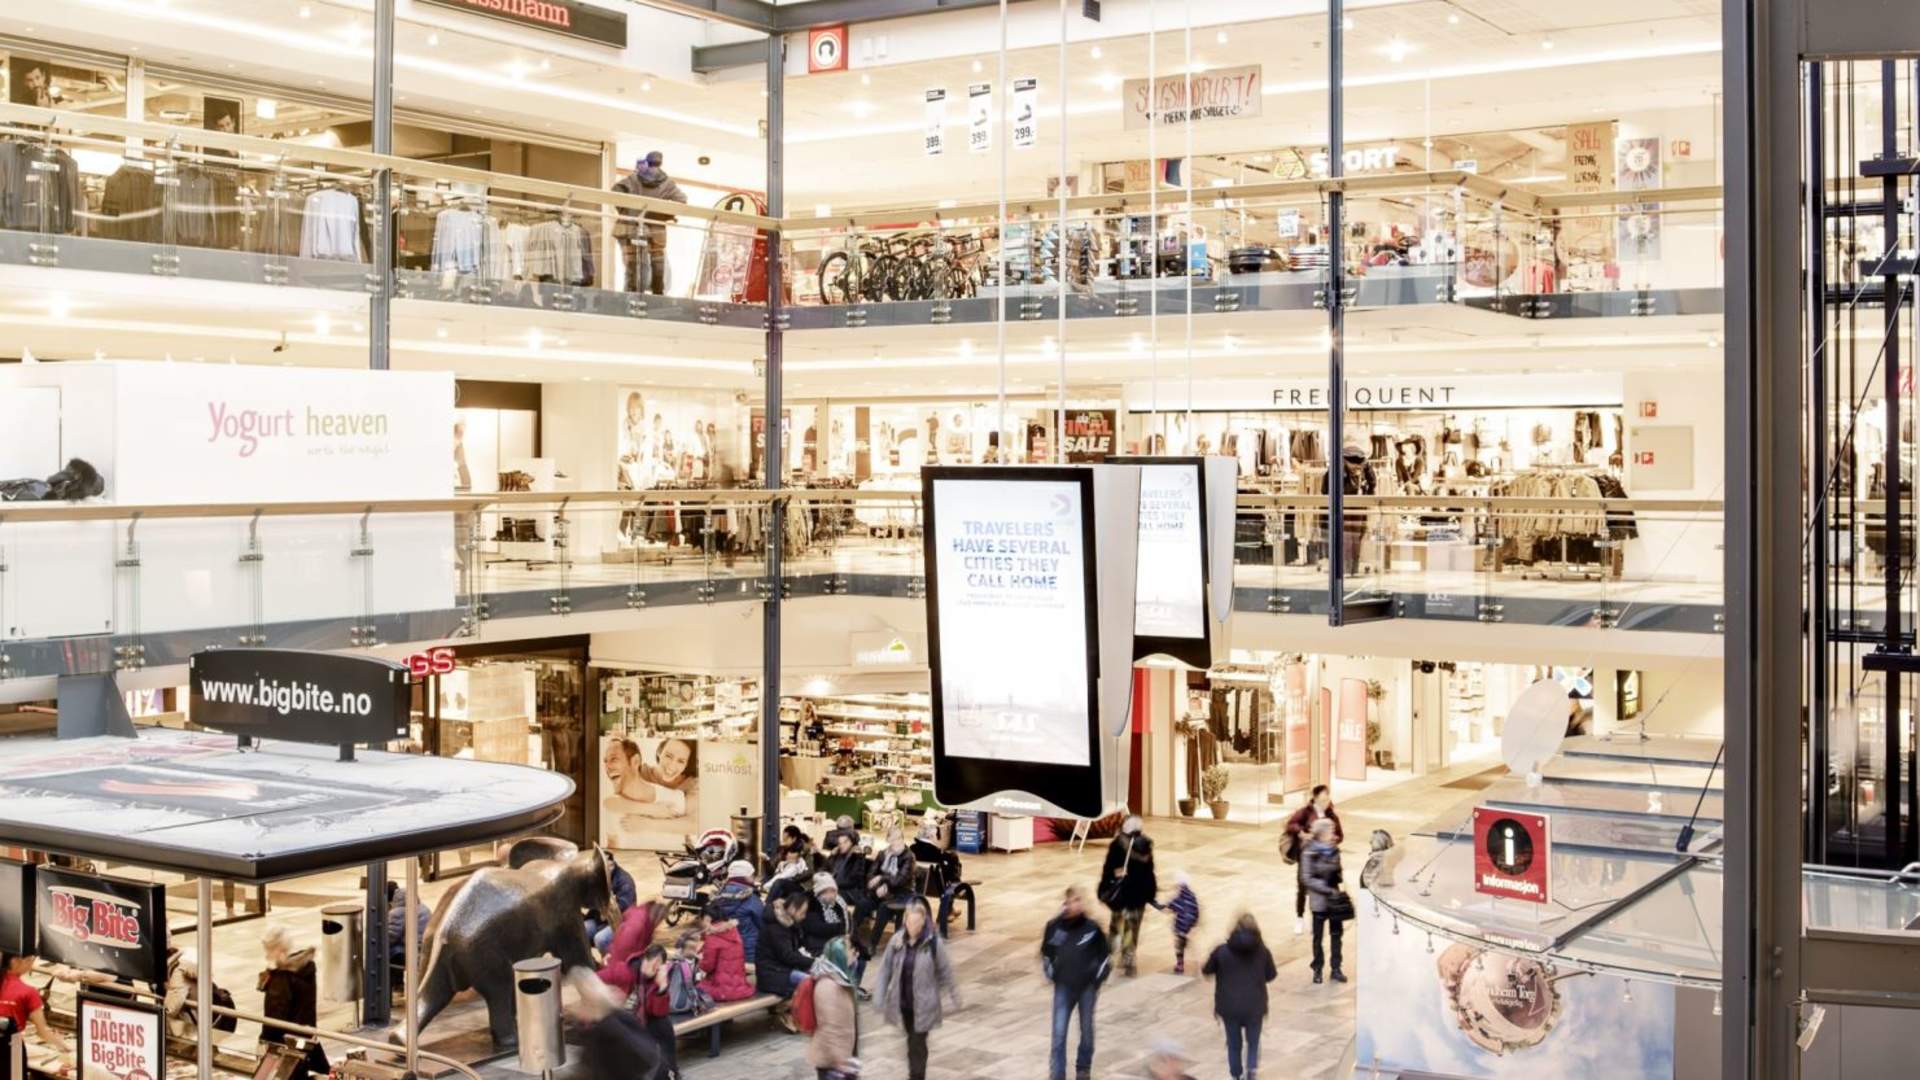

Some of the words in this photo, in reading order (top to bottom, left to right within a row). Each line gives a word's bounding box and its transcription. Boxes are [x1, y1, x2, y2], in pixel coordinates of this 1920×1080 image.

[1308, 147, 1398, 178] SORT
[208, 402, 295, 458] Yogurt
[306, 405, 388, 436] heaven
[1064, 419, 1113, 437] INAL
[1062, 436, 1111, 454] SALE
[962, 520, 1055, 537] TRAVELERS
[952, 538, 995, 553] HAVE
[998, 540, 1071, 556] SEVERAL
[964, 556, 1014, 572] CITIES
[1016, 558, 1060, 573] THEY
[967, 573, 1006, 589] CALL
[1010, 575, 1058, 590] HOME
[201, 678, 372, 716] www.bigbite.no
[704, 760, 752, 776] sunkost
[51, 891, 90, 943] Big
[92, 897, 140, 945] Bite
[90, 1018, 145, 1049] DAGENS
[91, 1042, 146, 1073] BigBite
